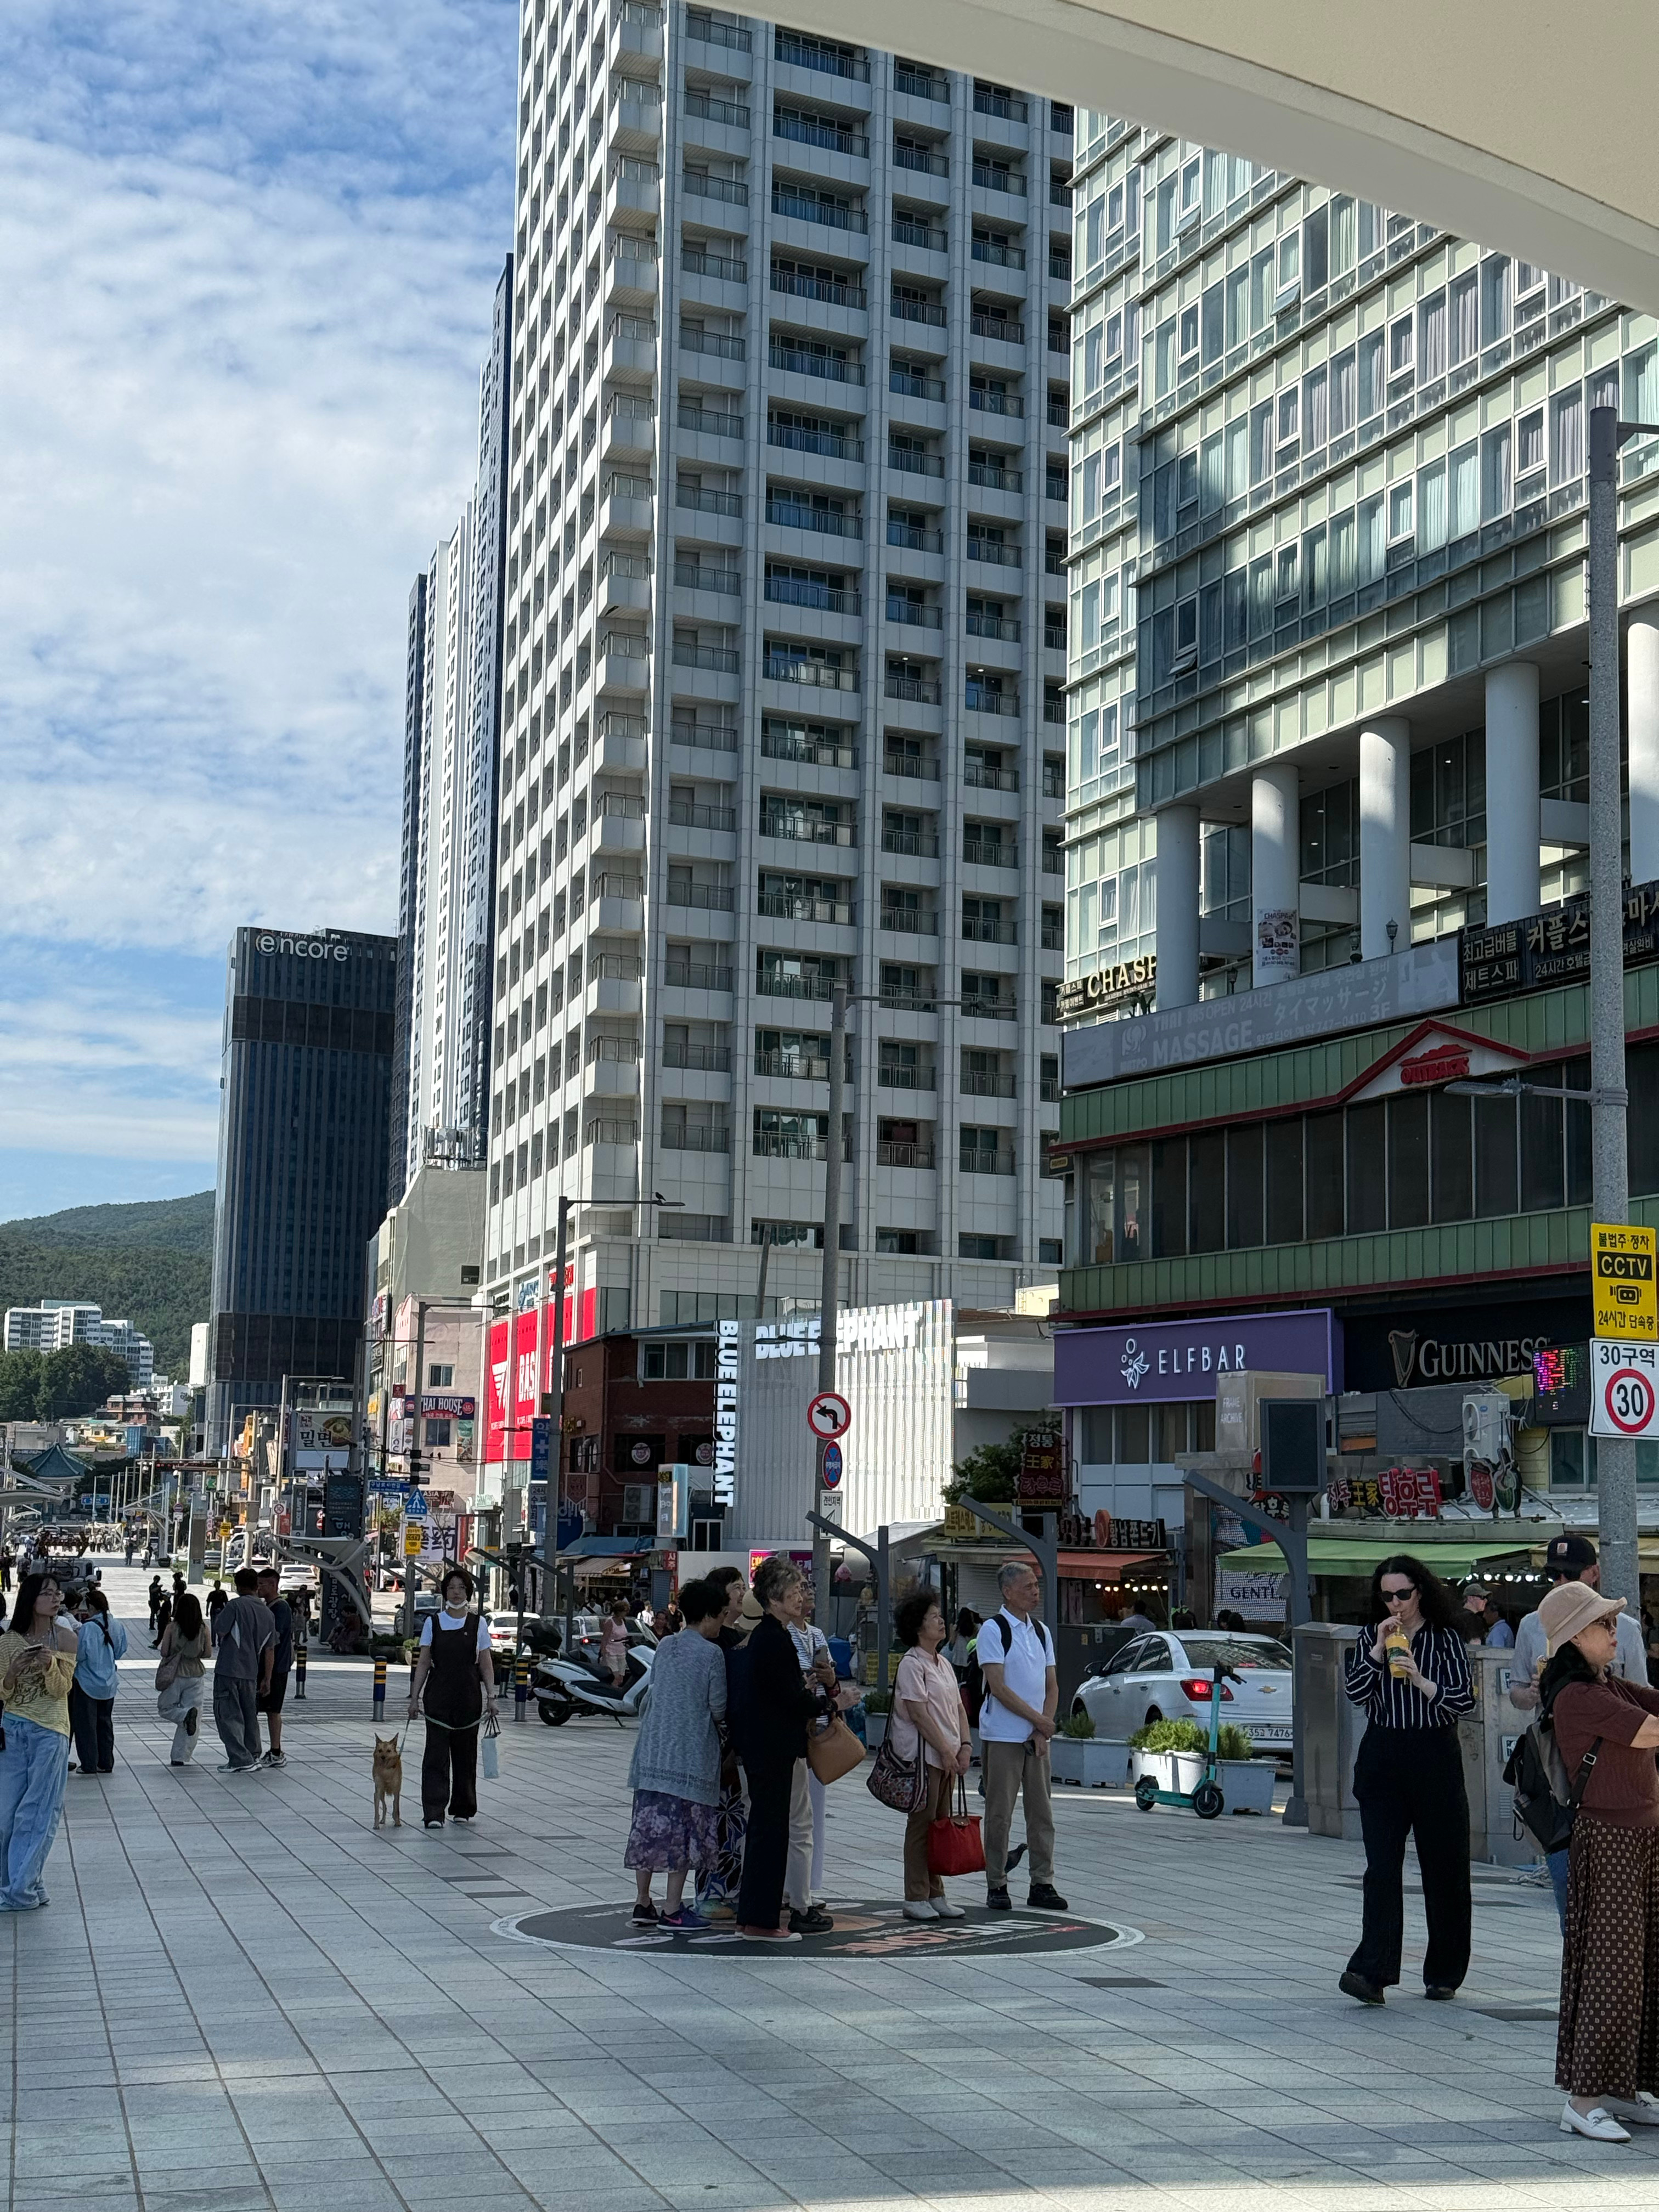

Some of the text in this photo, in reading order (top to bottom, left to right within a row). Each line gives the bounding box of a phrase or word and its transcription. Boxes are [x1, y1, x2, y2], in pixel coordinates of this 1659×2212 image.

[260, 935, 348, 962] encore
[1464, 960, 1519, 991] 제트스파
[1536, 961, 1564, 978] 24시간
[1154, 1011, 1182, 1032] THAI
[1206, 1000, 1235, 1020] OPEN
[1239, 991, 1273, 1012] 24시간
[1274, 976, 1387, 1026] タイマッサージ
[1370, 1001, 1391, 1021] 3F
[1153, 1020, 1252, 1067] MASSAGE
[1601, 1255, 1647, 1277] CCTV
[1598, 1310, 1654, 1331] 24시간 단속중
[755, 1309, 918, 1360] BLUE EEPHANT
[1158, 1344, 1246, 1374] ELFBAR
[1600, 1345, 1655, 1368] 30구역
[438, 1397, 463, 1416] HOUSE
[1222, 1396, 1240, 1408] FRAME
[1616, 1384, 1644, 1417] 30
[714, 1319, 738, 1507] BLUE ELEPHANT
[300, 1430, 334, 1448] 밀면
[1028, 1434, 1054, 1448] 정통
[1026, 1454, 1054, 1470] 王家
[1327, 1477, 1352, 1511] 정통
[1352, 1481, 1379, 1507] 王家
[1378, 1470, 1438, 1517] 탕후루
[1267, 1729, 1290, 1739] 7476
